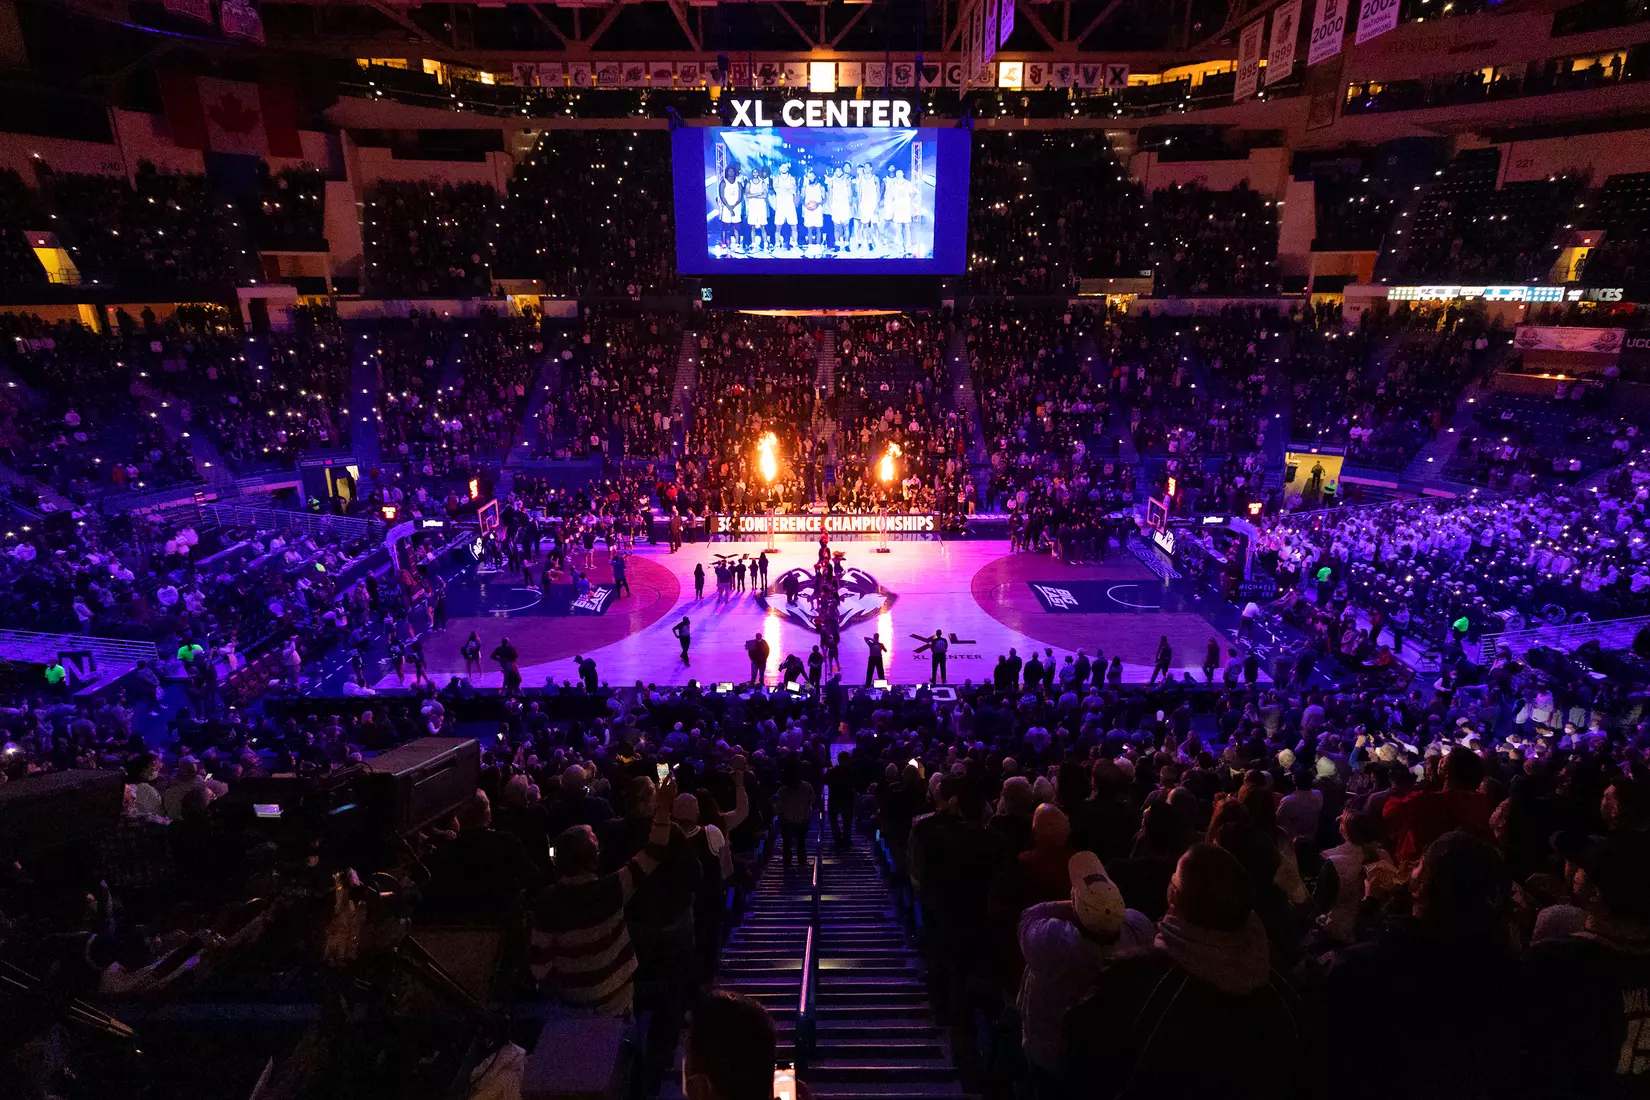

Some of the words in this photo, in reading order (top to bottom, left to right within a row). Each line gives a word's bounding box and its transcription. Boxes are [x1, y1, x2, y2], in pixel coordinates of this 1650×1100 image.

[1312, 16, 1343, 44] 2000
[1359, 21, 1392, 41] CHAMPIONS
[1270, 43, 1292, 65] 1999
[1109, 67, 1126, 84] X
[1238, 61, 1258, 81] 1995
[731, 100, 773, 127] XL
[782, 99, 911, 127] CENTER
[1515, 159, 1534, 168] 221
[824, 516, 934, 532] CHAMPIONSHIPS
[1238, 583, 1277, 591] MICHAELS
